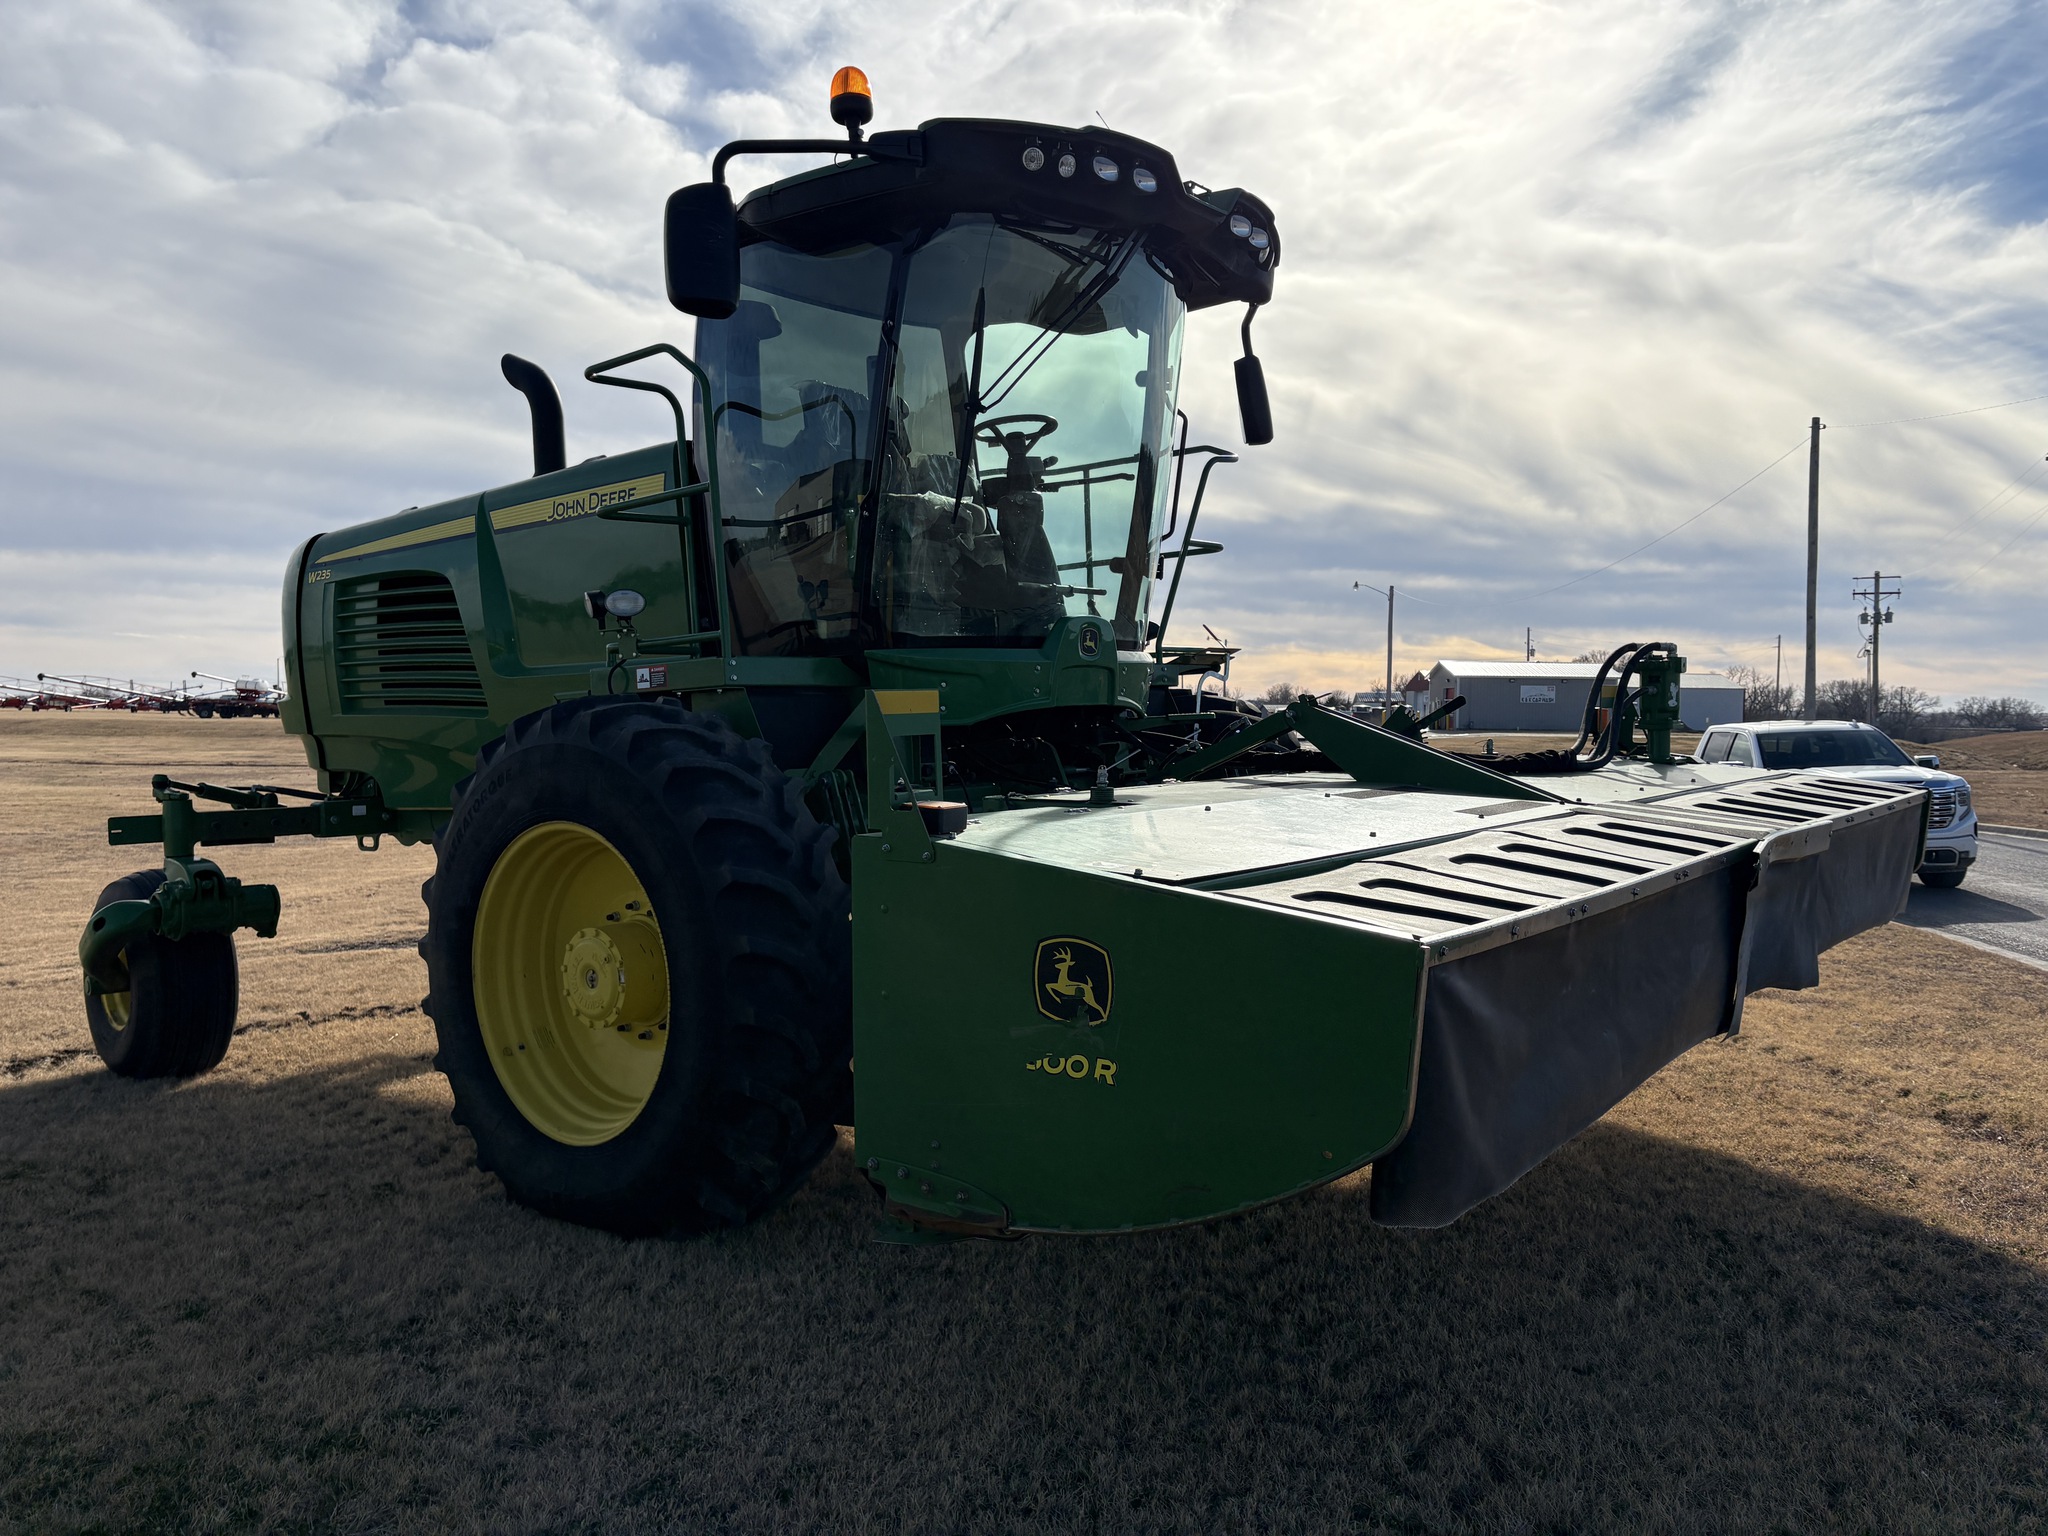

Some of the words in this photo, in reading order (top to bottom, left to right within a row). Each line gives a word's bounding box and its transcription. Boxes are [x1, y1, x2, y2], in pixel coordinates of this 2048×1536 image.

[547, 498, 585, 520] JOHN
[588, 487, 637, 511] DEERE
[308, 569, 331, 584] W235
